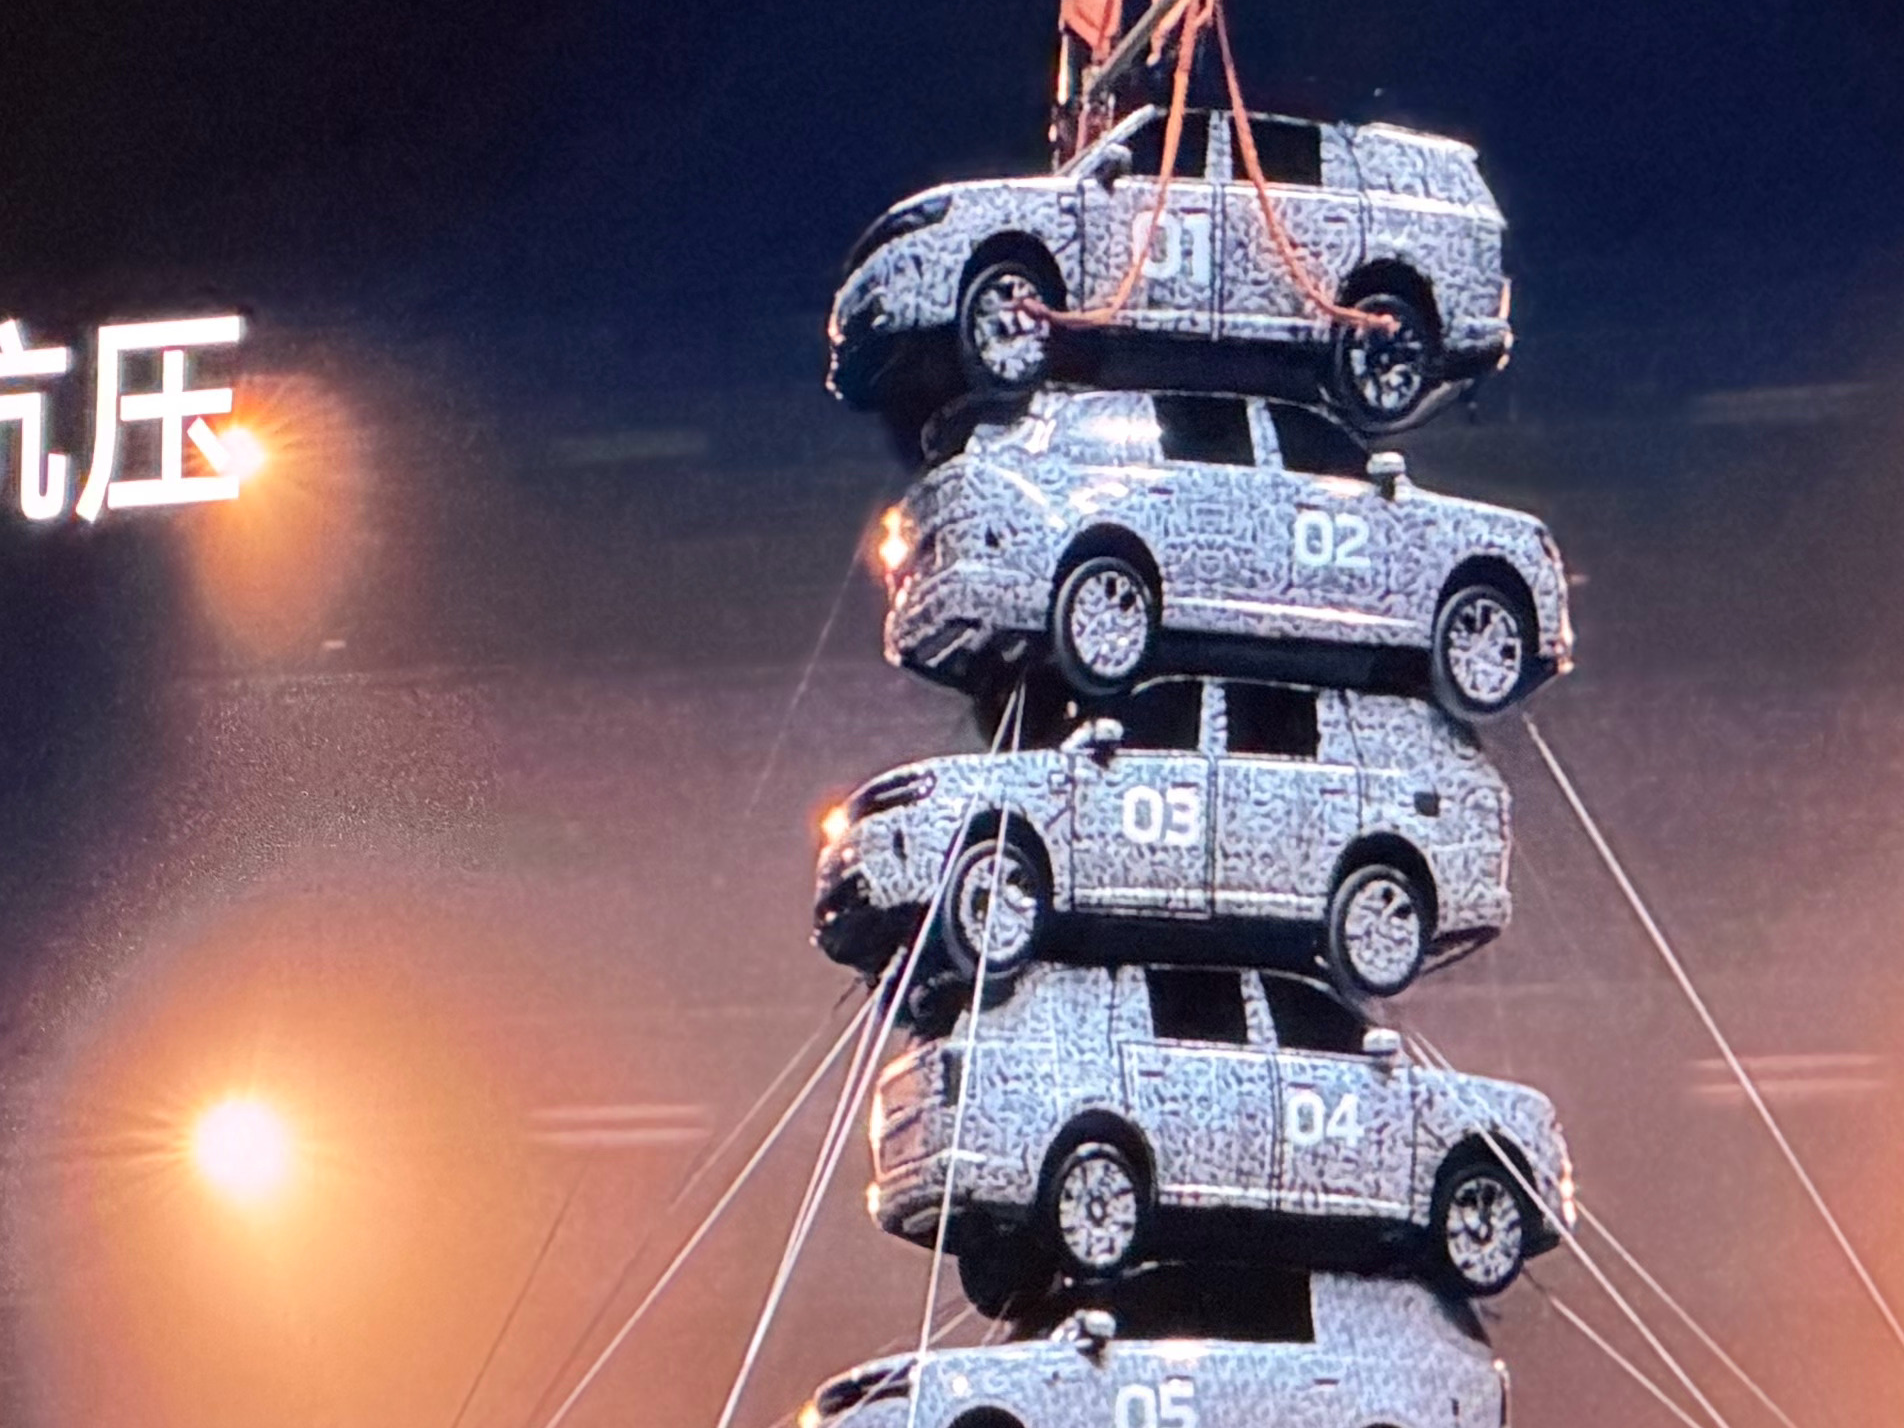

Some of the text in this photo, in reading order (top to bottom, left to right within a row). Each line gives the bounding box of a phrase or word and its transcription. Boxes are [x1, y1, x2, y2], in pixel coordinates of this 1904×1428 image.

[1133, 211, 1210, 284] 01
[1294, 510, 1371, 567] 02
[1123, 785, 1200, 846] 03
[1287, 1091, 1364, 1148] 04
